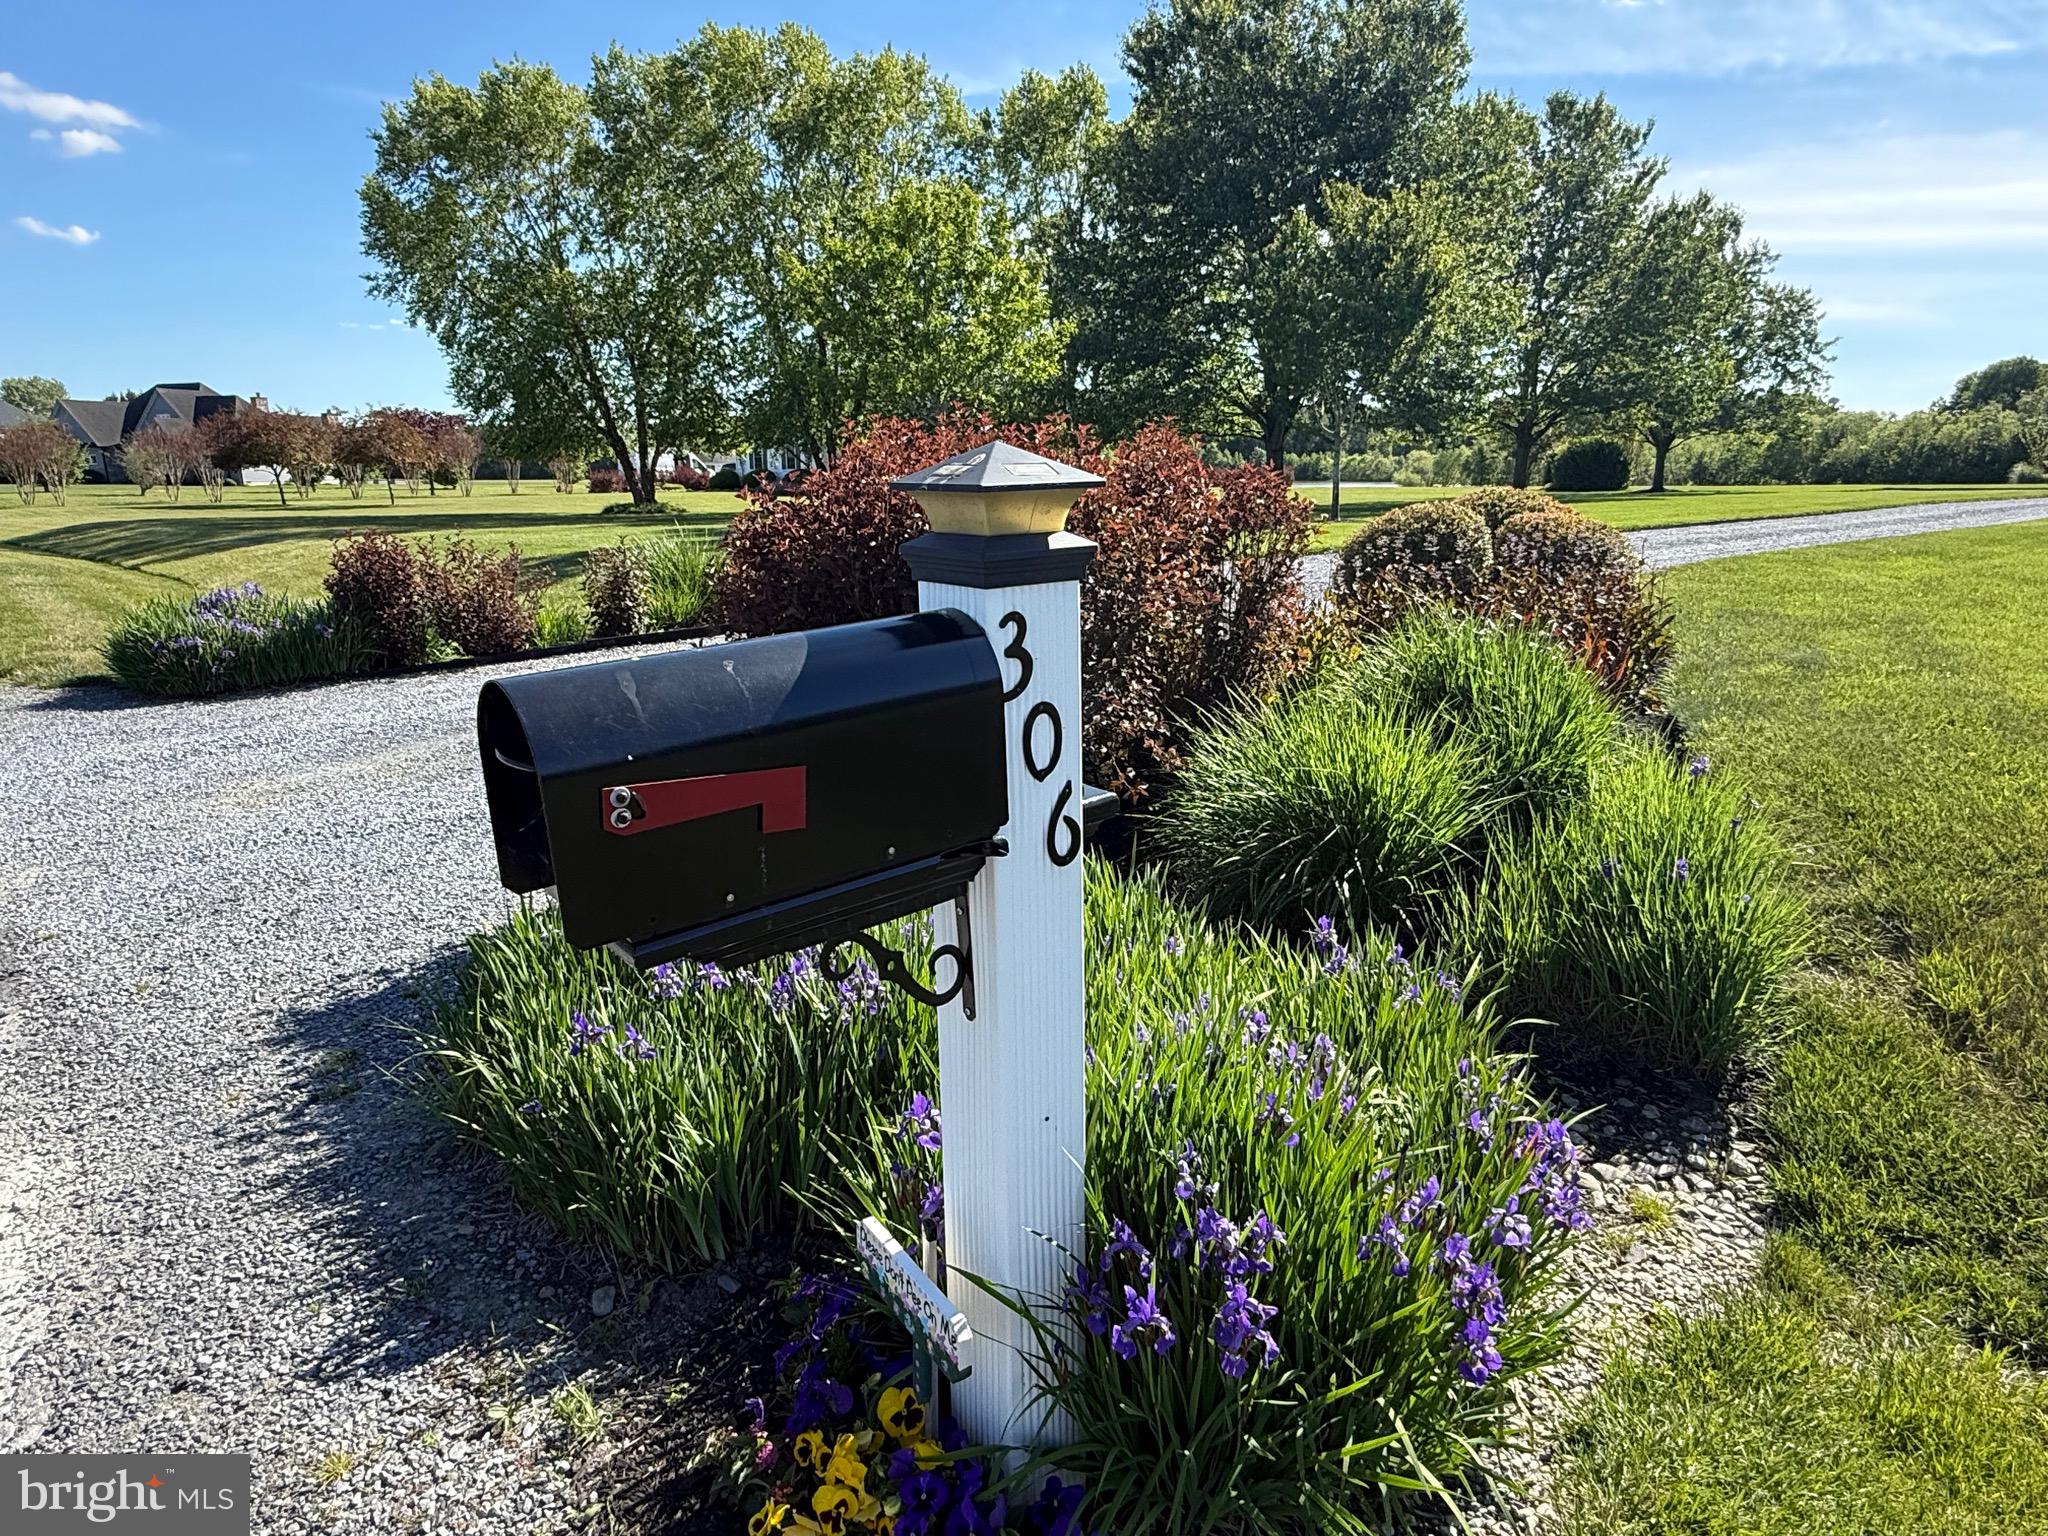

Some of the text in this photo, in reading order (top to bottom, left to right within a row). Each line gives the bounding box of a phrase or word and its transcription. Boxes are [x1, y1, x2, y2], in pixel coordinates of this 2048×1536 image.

[1000, 611, 1081, 867] 306
[860, 1228, 883, 1263] Please
[906, 1280, 922, 1311] Pee
[923, 1303, 938, 1328] On
